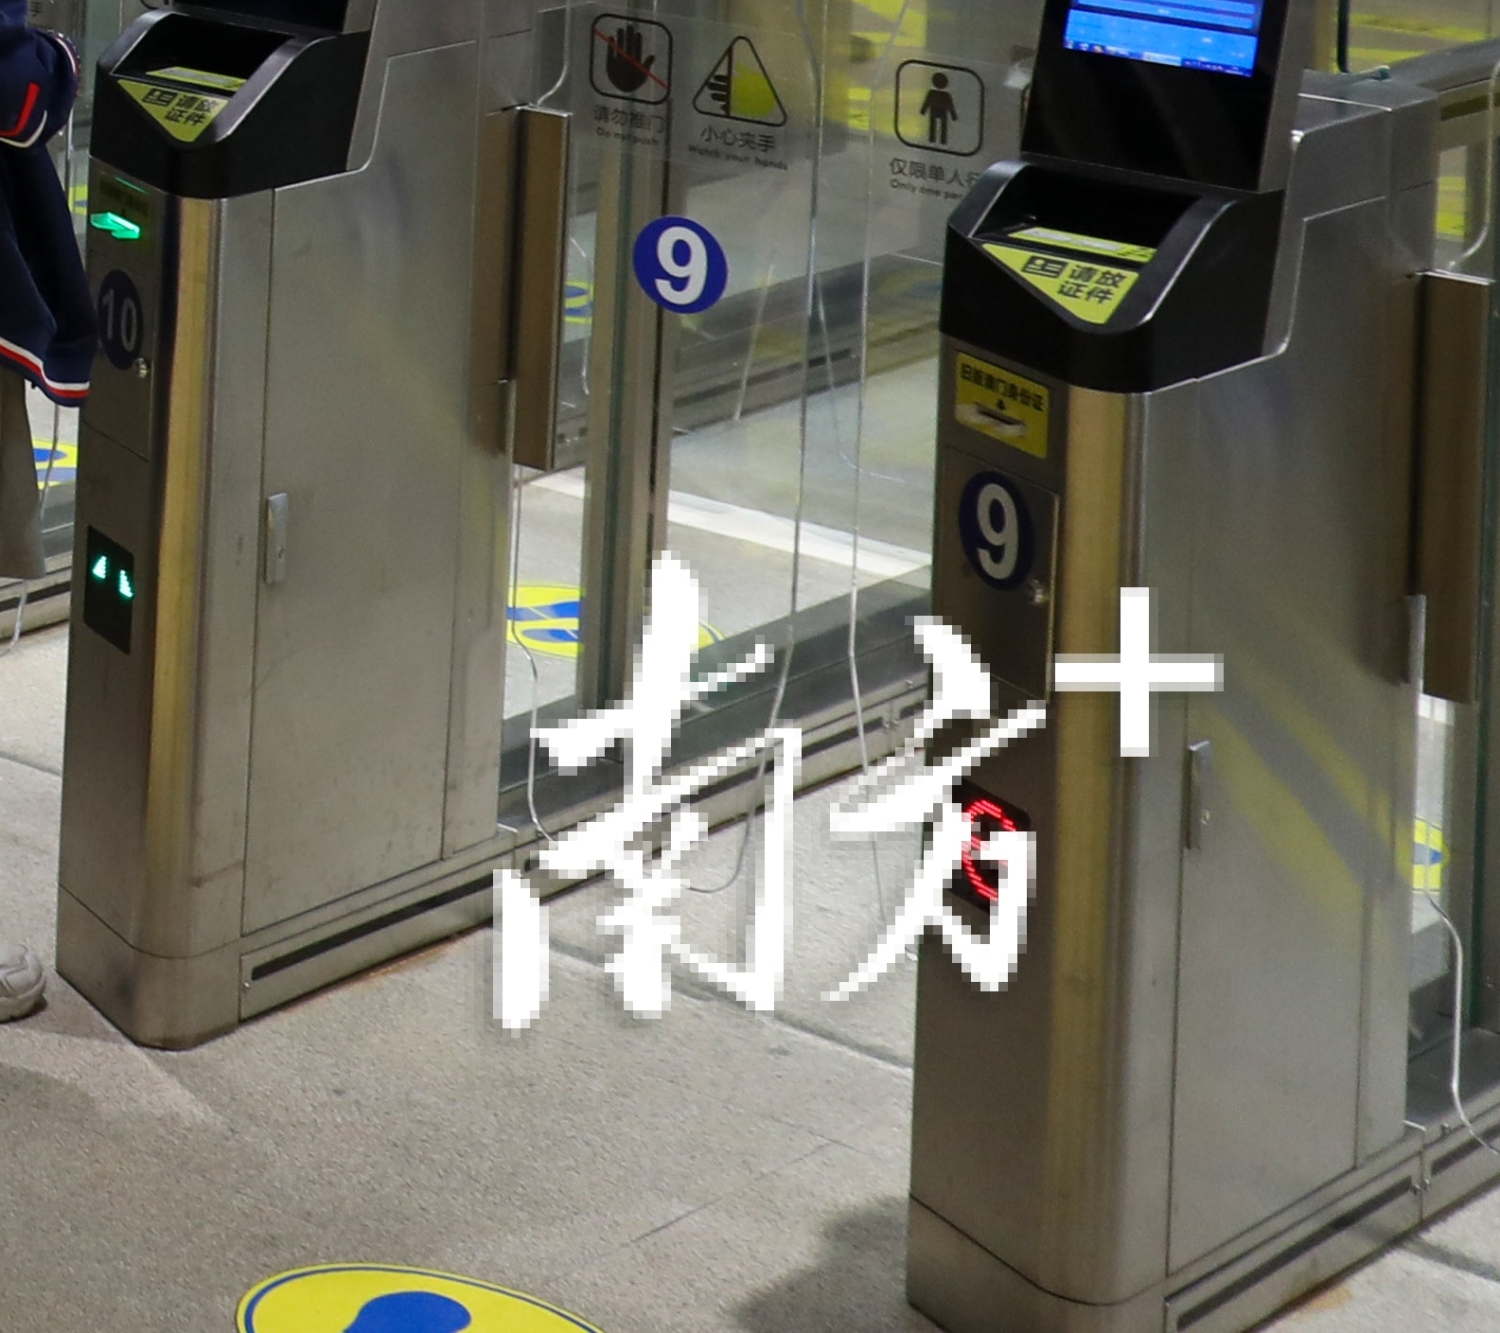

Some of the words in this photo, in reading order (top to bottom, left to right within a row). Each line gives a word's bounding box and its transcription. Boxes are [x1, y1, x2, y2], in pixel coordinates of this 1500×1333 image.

[165, 108, 207, 127] 证件
[177, 95, 222, 115] 请放
[593, 106, 664, 134] 请勿推门
[700, 124, 777, 153] 小心夹手
[754, 157, 788, 172] hands
[889, 178, 916, 194] Only
[654, 226, 705, 306] 9
[1068, 264, 1127, 289] 请放
[1057, 282, 1115, 305] 证件
[103, 288, 137, 352] 10
[975, 482, 1020, 580] 9
